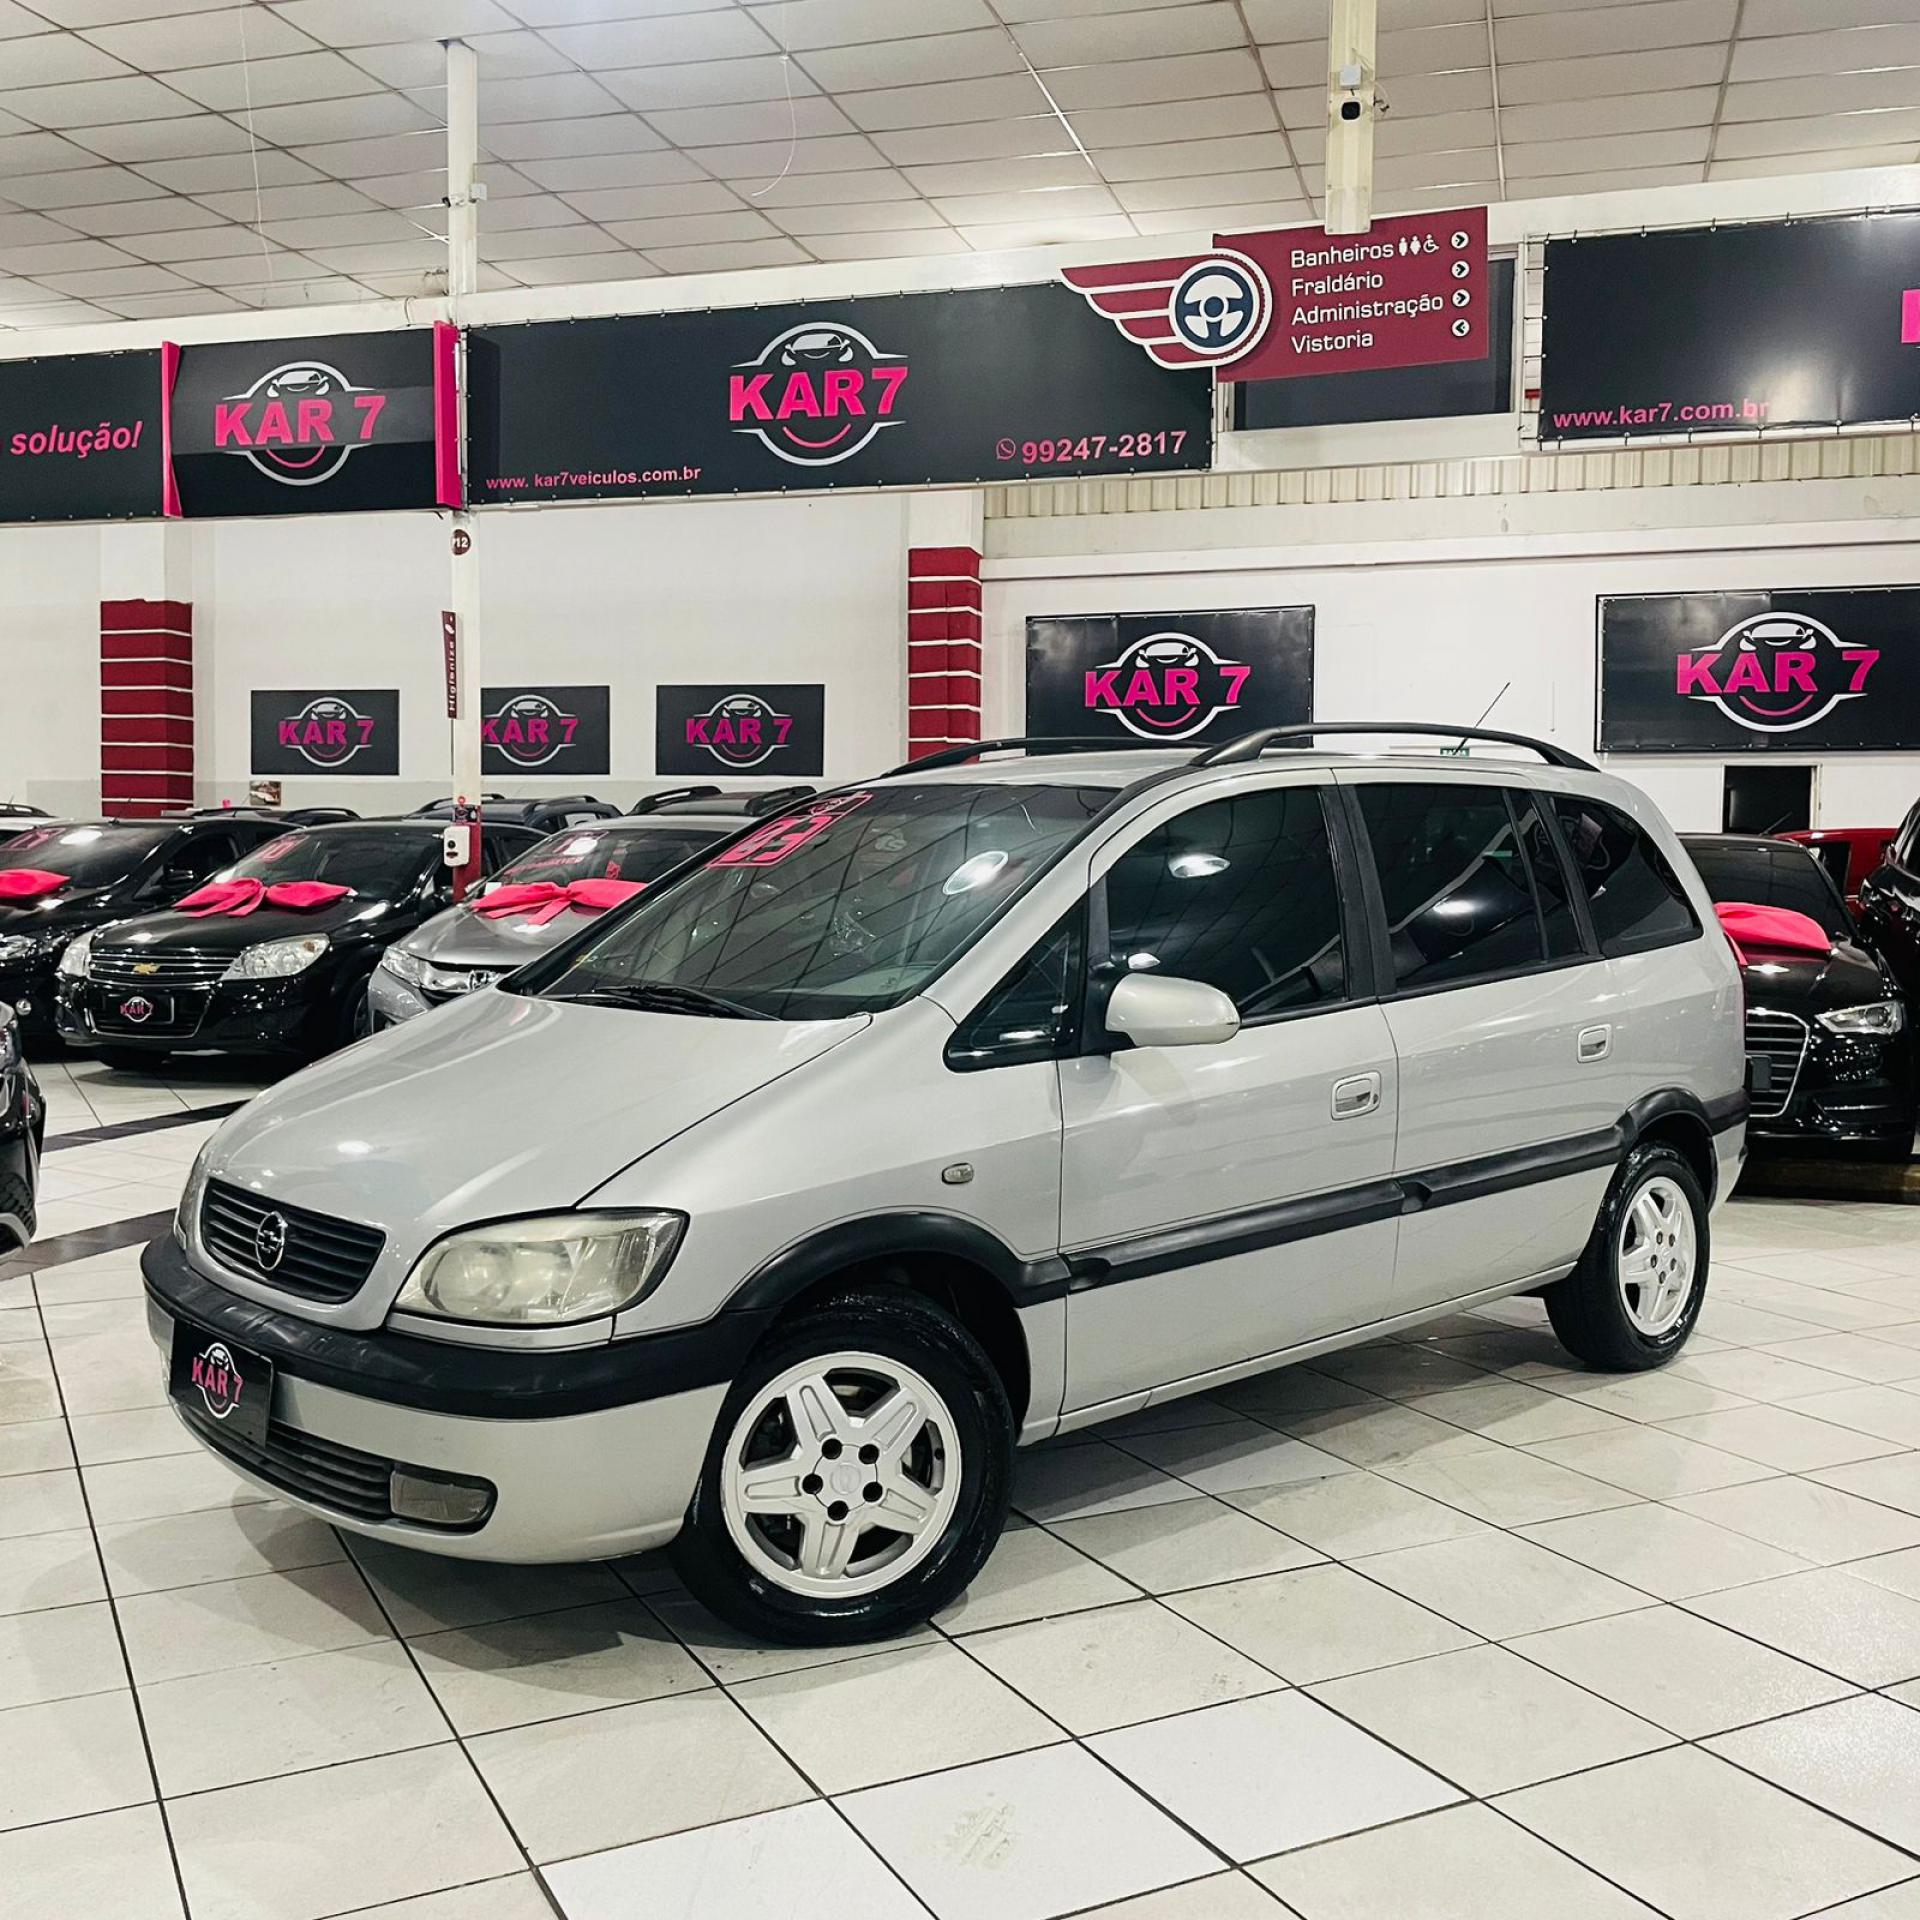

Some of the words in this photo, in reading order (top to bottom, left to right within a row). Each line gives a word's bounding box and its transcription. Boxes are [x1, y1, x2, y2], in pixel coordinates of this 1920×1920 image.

[1290, 243, 1394, 269] Banheiros
[1291, 271, 1384, 298] Fraldário
[1290, 293, 1445, 326] Administração
[1290, 330, 1375, 354] Vistoria
[214, 398, 335, 447] KAR
[352, 394, 387, 441] 7
[1552, 397, 1769, 429] www.kar7.com.br
[9, 420, 144, 459] solução!
[1021, 430, 1188, 466] 99247-2817
[1084, 666, 1202, 708] KAR
[1218, 664, 1252, 705] 7
[1675, 650, 1819, 695] KAR
[1841, 648, 1881, 693] 7
[279, 719, 347, 745] KAR
[356, 719, 375, 744] 7
[481, 717, 549, 744] KAR
[559, 717, 579, 744] 7
[685, 717, 762, 745] KAR
[773, 717, 794, 744] 7
[191, 1356, 229, 1398] KAR
